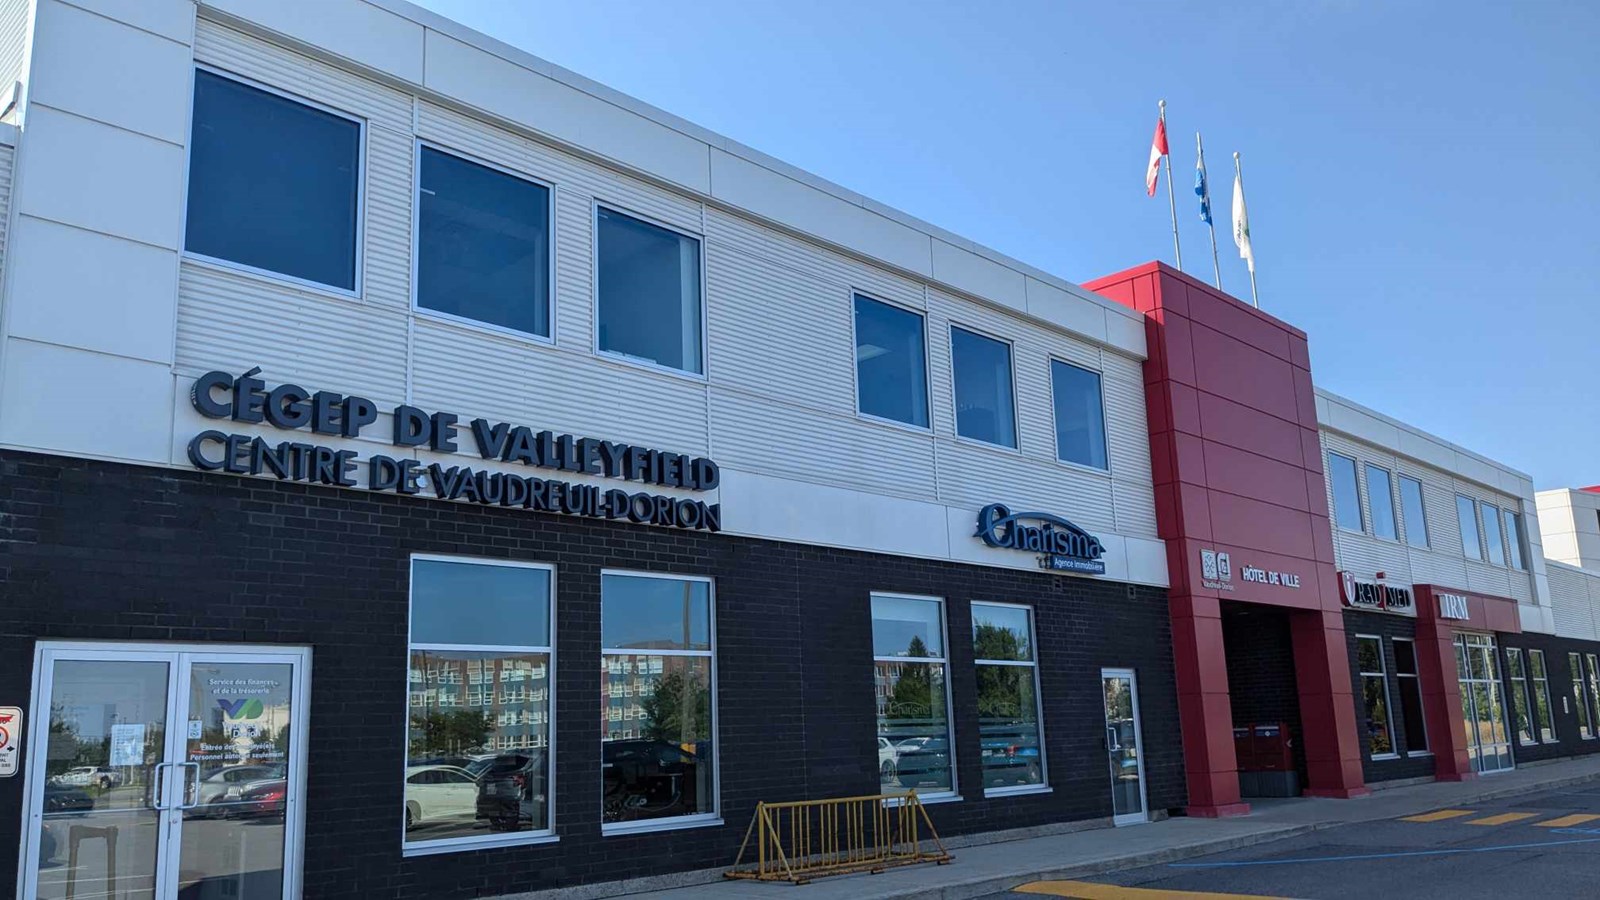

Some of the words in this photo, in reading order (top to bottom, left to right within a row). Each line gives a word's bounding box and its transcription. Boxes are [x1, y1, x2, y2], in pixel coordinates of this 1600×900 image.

[190, 366, 378, 438] CÉGEP
[393, 405, 458, 454] DE
[470, 418, 720, 491] VALLEYFIELD
[187, 430, 359, 487] CENTRE
[369, 455, 421, 494] DE
[428, 462, 721, 532] VAUDREUIL-DORION
[973, 503, 1105, 560] Charisma
[1054, 558, 1074, 569] Agence
[1241, 565, 1268, 583] HÔTEL
[1268, 571, 1280, 585] DE
[1280, 573, 1300, 588] VILLE
[209, 678, 234, 686] Service
[234, 678, 247, 686] des
[247, 678, 274, 686] finances
[212, 687, 221, 695] et
[221, 687, 231, 695] de
[231, 687, 238, 695] la
[190, 753, 223, 761] Personnel
[251, 751, 284, 759] seulement
